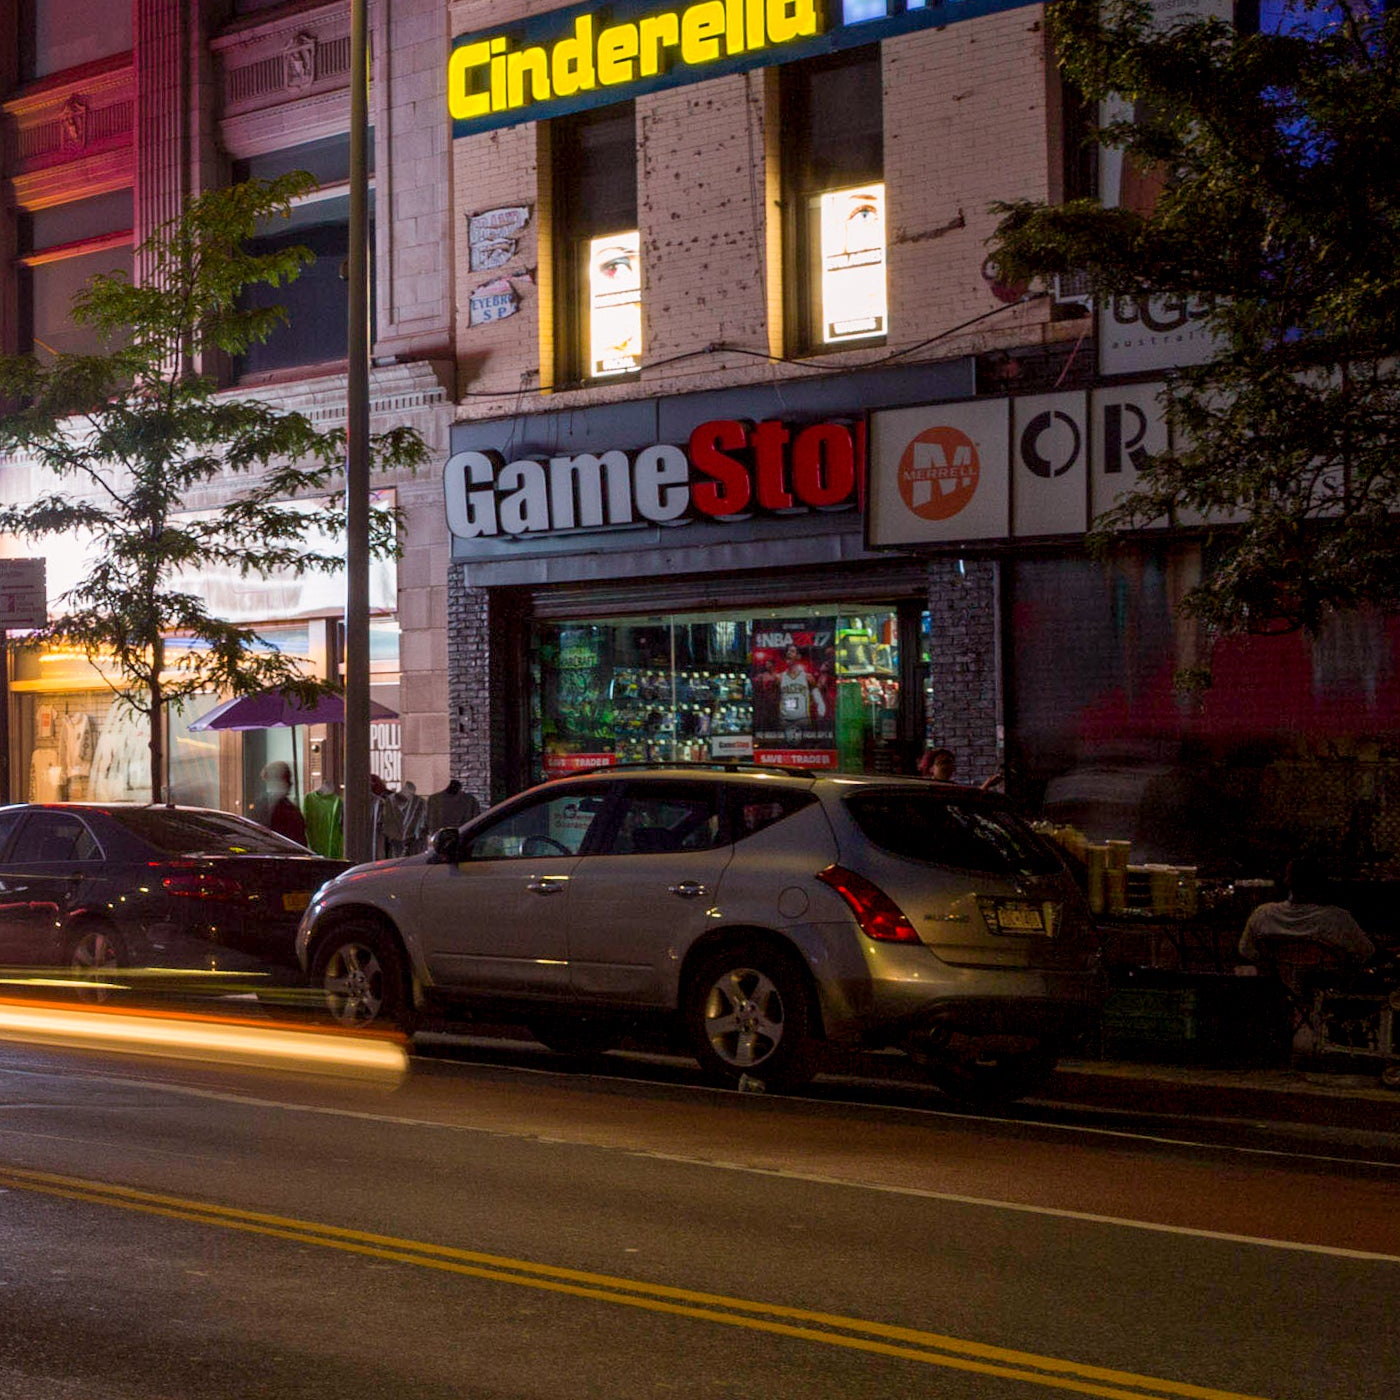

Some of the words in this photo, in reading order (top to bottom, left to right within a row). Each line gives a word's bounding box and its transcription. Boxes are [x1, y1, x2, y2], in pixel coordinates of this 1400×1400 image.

[445, 417, 866, 542] GameSto
[903, 465, 977, 481] MERRELL
[762, 632, 794, 648] NBA
[575, 756, 602, 766] TRADE
[761, 753, 783, 763] SAVE
[791, 753, 821, 763] TRADE
